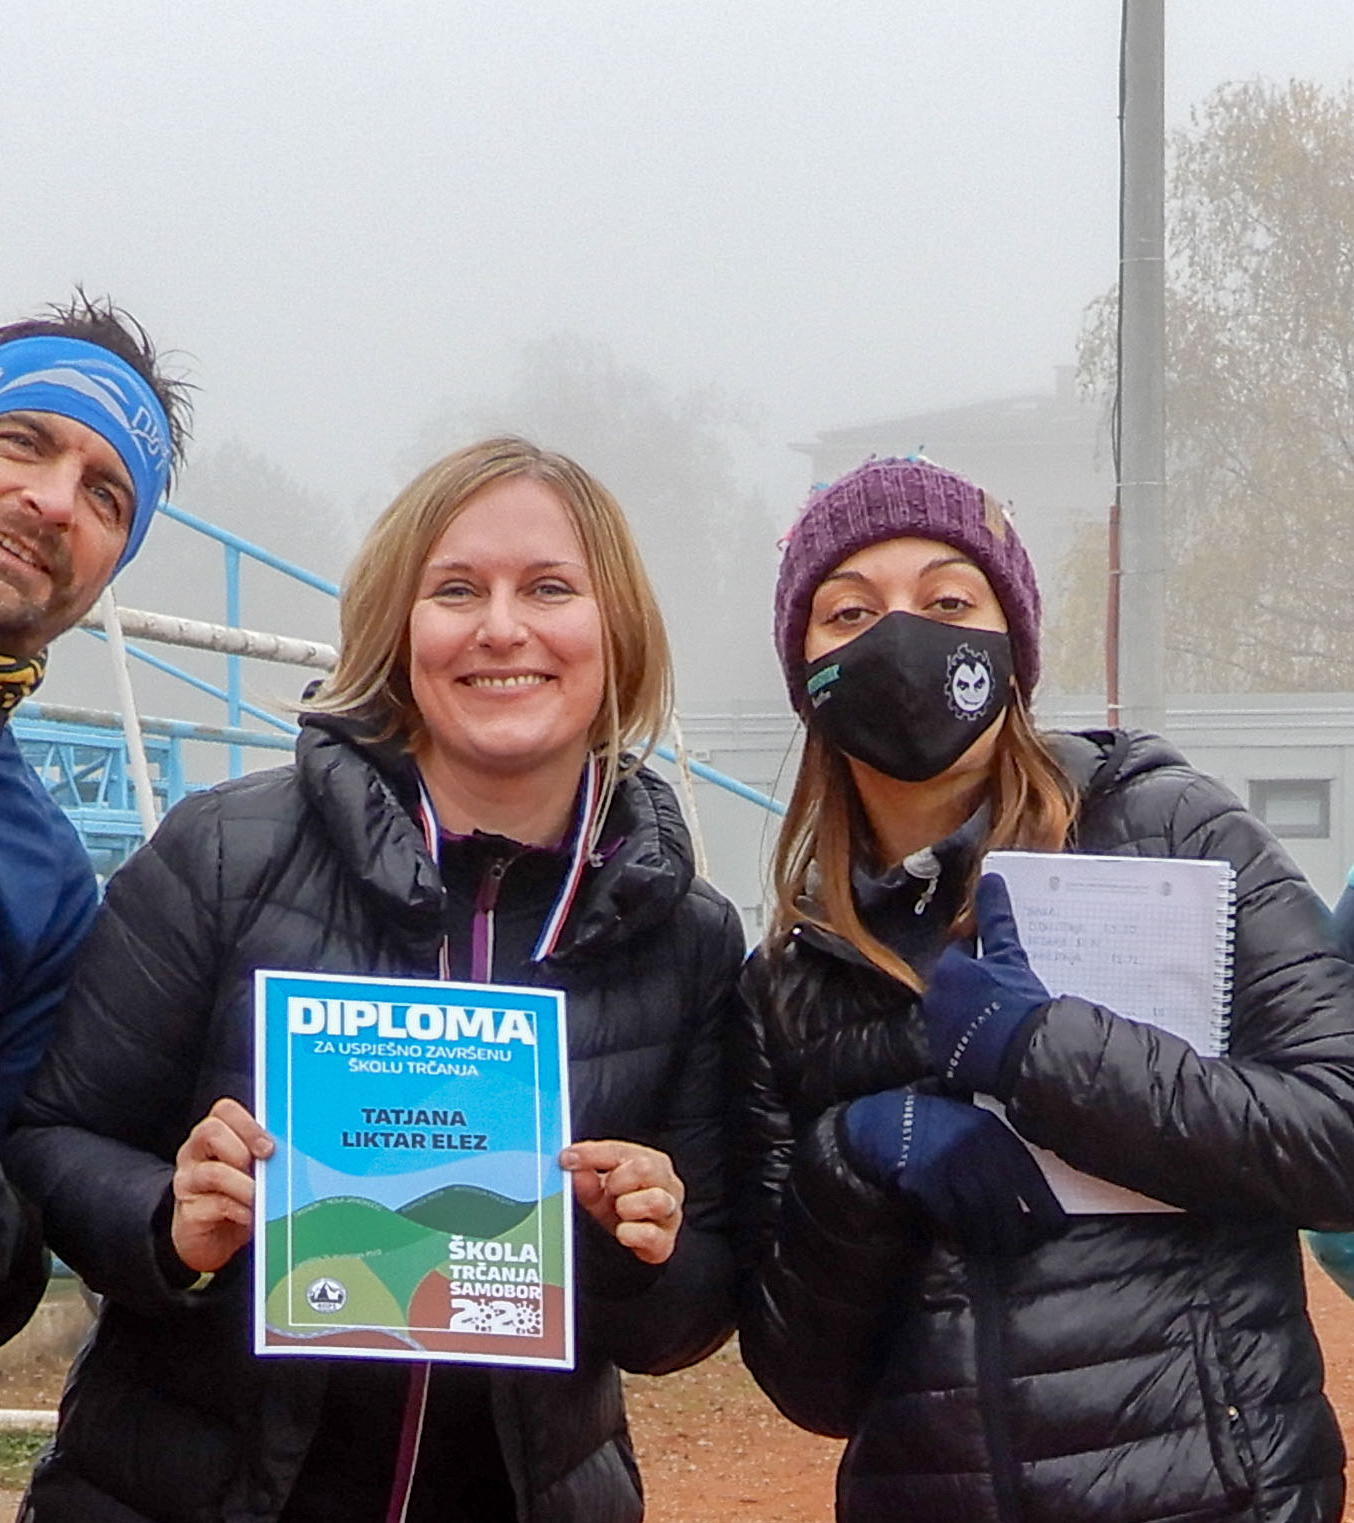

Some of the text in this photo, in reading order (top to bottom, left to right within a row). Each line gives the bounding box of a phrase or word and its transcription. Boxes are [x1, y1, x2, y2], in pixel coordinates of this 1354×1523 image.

[288, 997, 536, 1046] DIPLOMA
[313, 1040, 512, 1062] ZA USPJEŠNO ZAVRŠENU
[348, 1057, 479, 1077] ŠKOLU TRČANJA
[361, 1108, 467, 1126] TATJANA
[342, 1131, 488, 1151] LIKTAR ELEZ
[448, 1234, 539, 1263] ŠKOLA
[449, 1262, 540, 1283] TRČANJA
[449, 1281, 542, 1300] SAMOBOR
